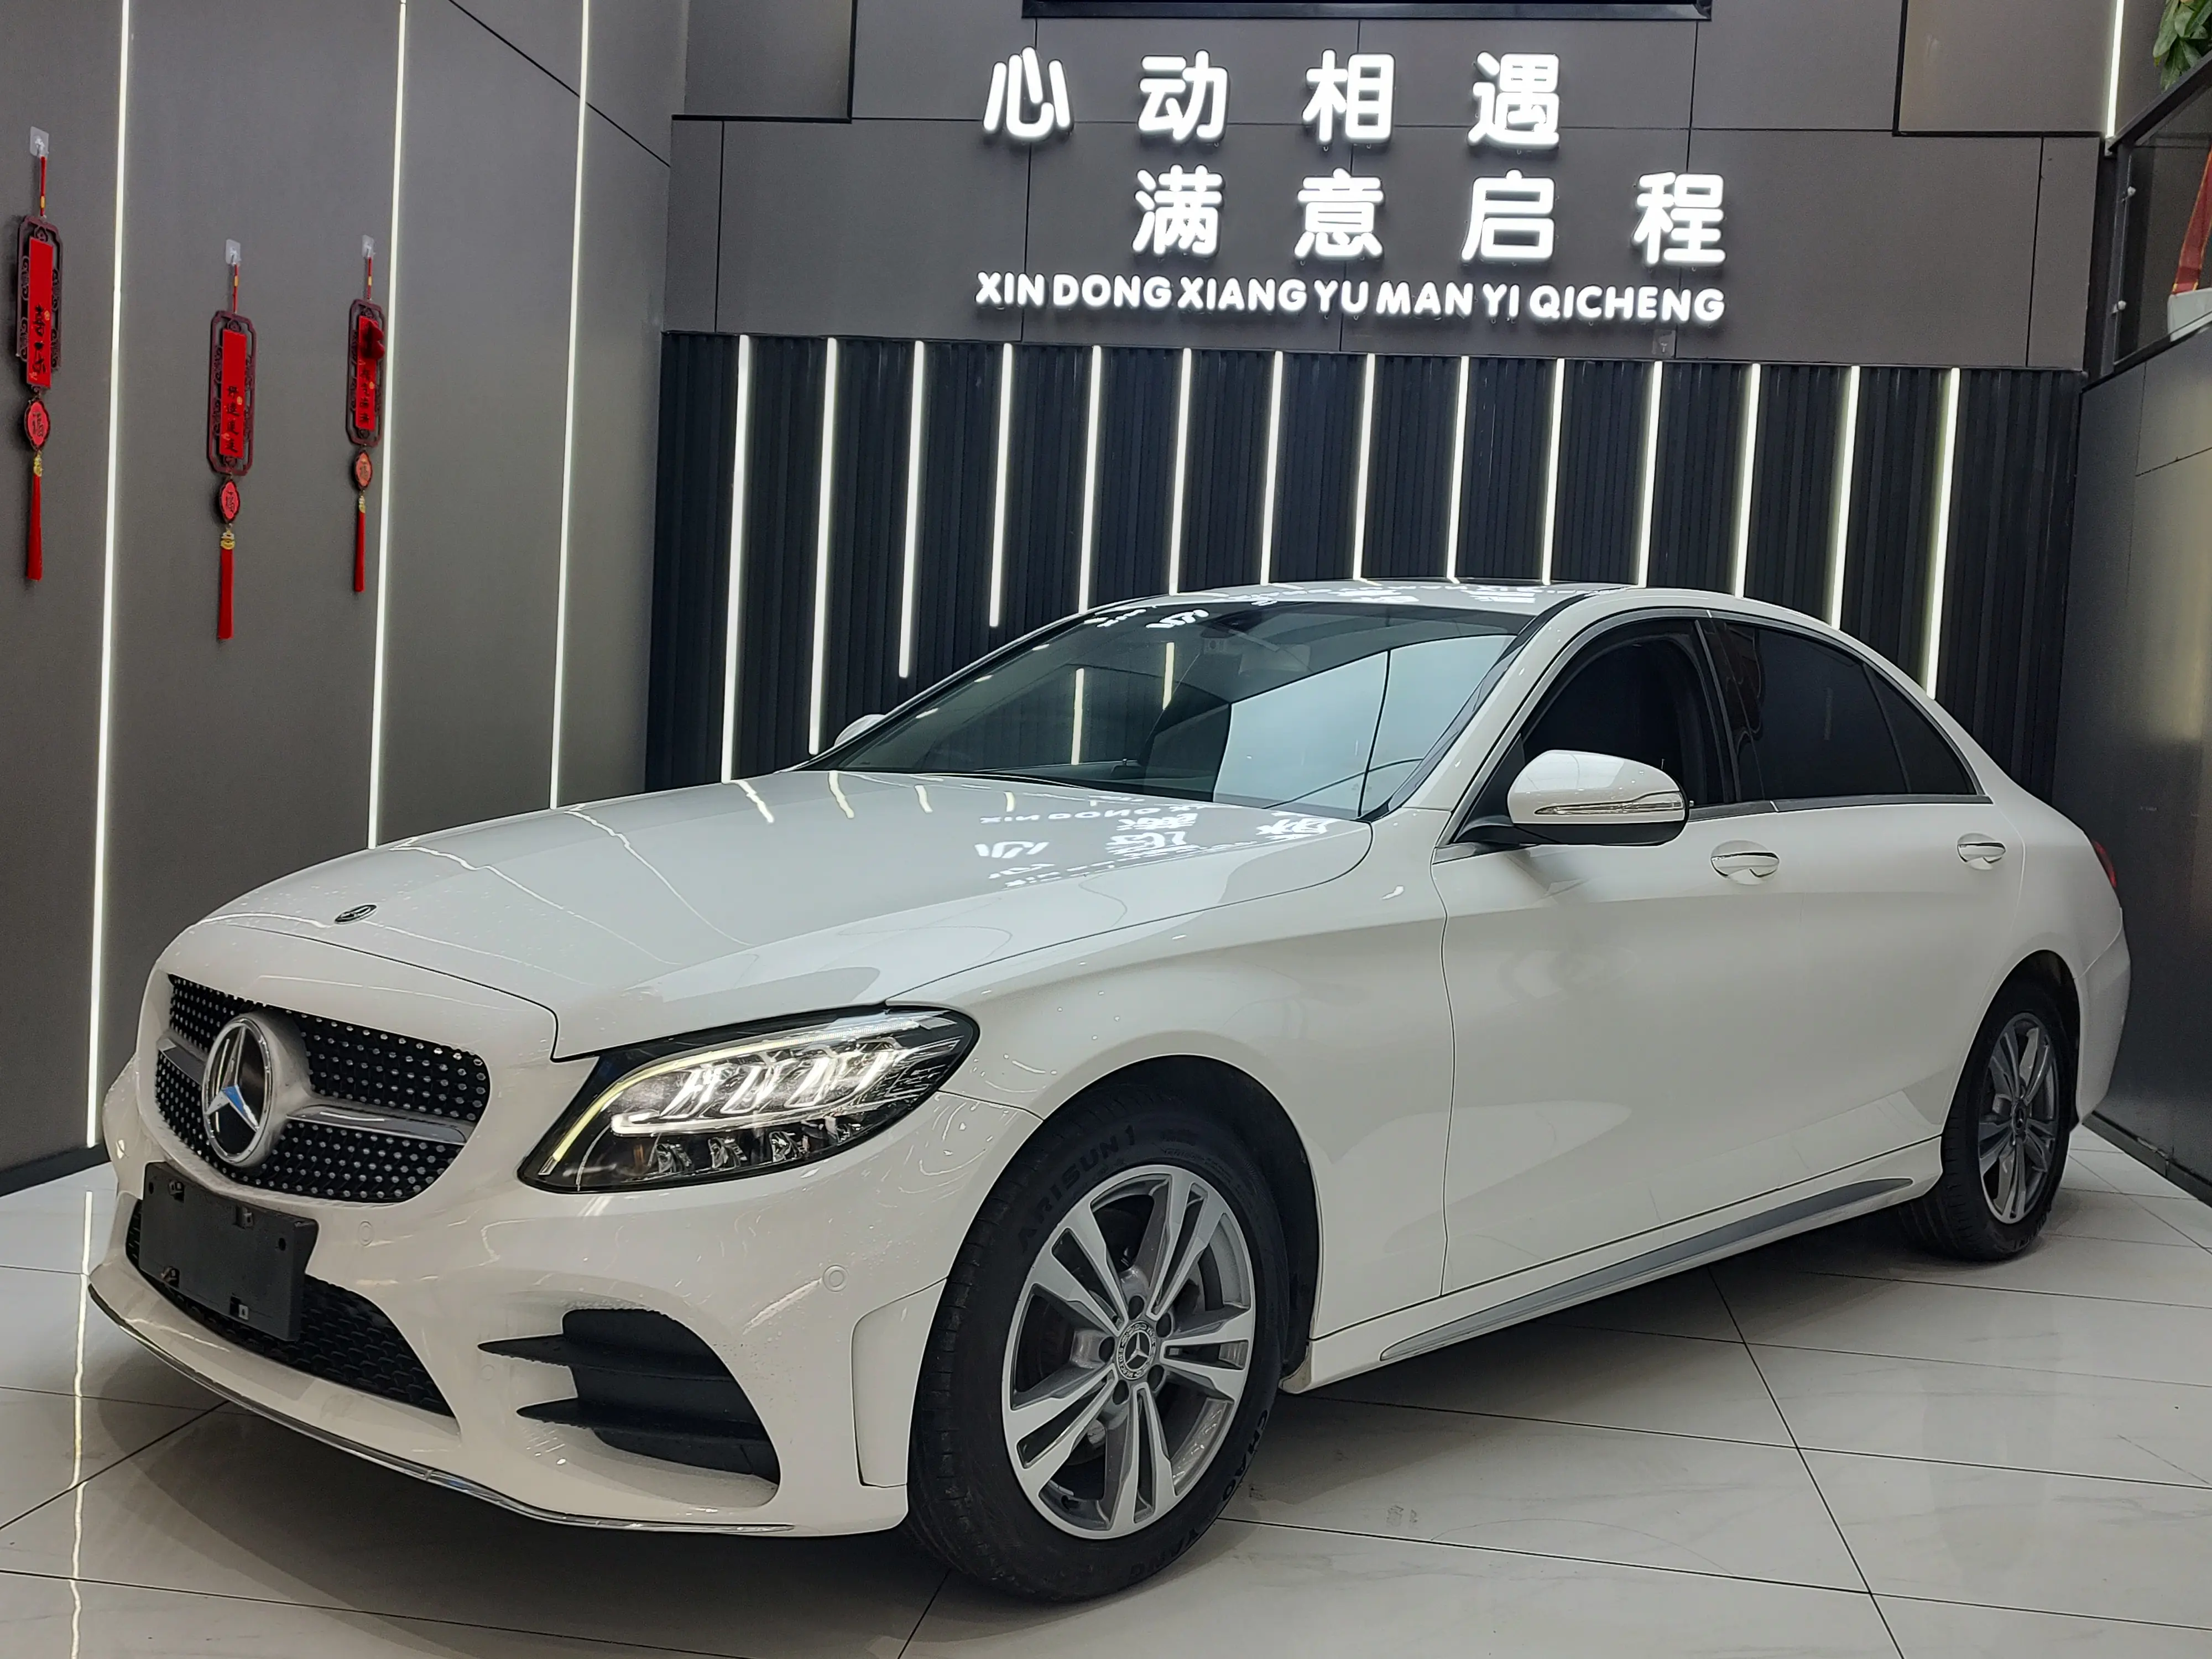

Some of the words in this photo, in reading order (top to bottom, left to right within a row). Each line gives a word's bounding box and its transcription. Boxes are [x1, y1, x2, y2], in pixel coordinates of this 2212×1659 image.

[984, 47, 1559, 148] 心动相遇
[1132, 164, 1725, 264] 满意启程
[975, 272, 1045, 306] XIN
[1053, 274, 1172, 308] DONG
[1177, 276, 1307, 311] XIANG
[1314, 280, 1369, 314] YU
[1376, 281, 1473, 315] MAN
[1482, 283, 1520, 317] YI
[1529, 285, 1725, 322] QICHENG
[1018, 1134, 1119, 1250] ARISUN
